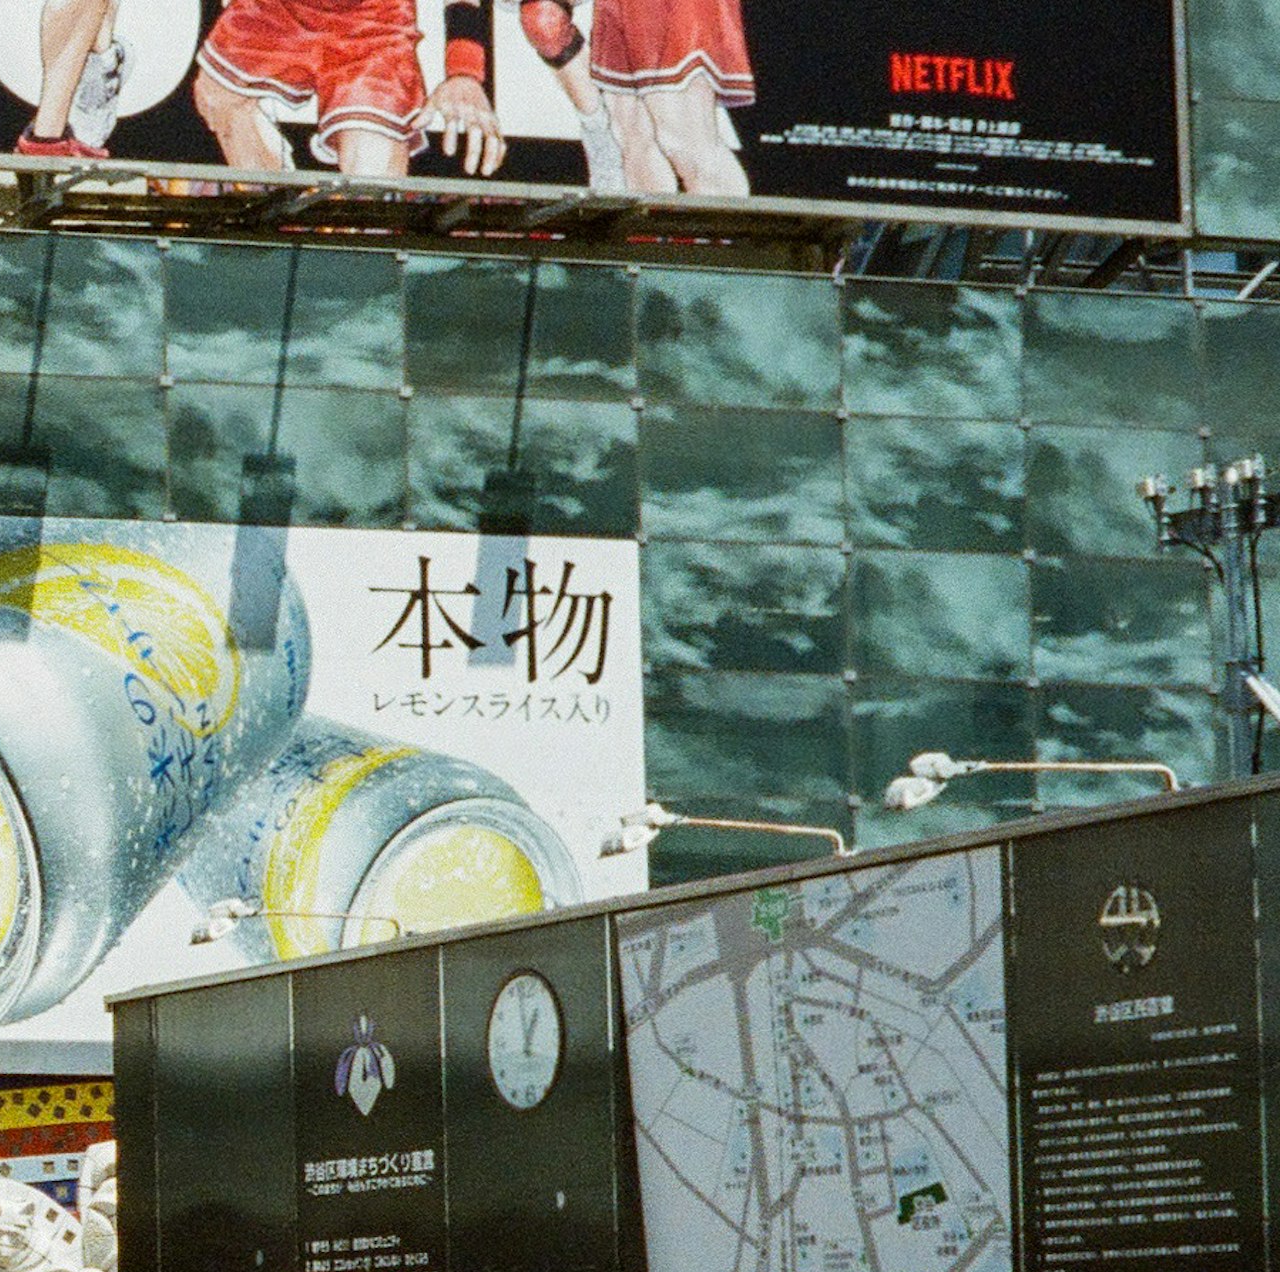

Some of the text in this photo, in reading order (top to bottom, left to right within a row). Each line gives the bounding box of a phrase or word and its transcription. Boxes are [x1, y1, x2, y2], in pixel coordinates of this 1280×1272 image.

[889, 52, 1016, 100] NETFLIX
[368, 555, 614, 686] 本物
[373, 693, 611, 723] レモンスライス入り
